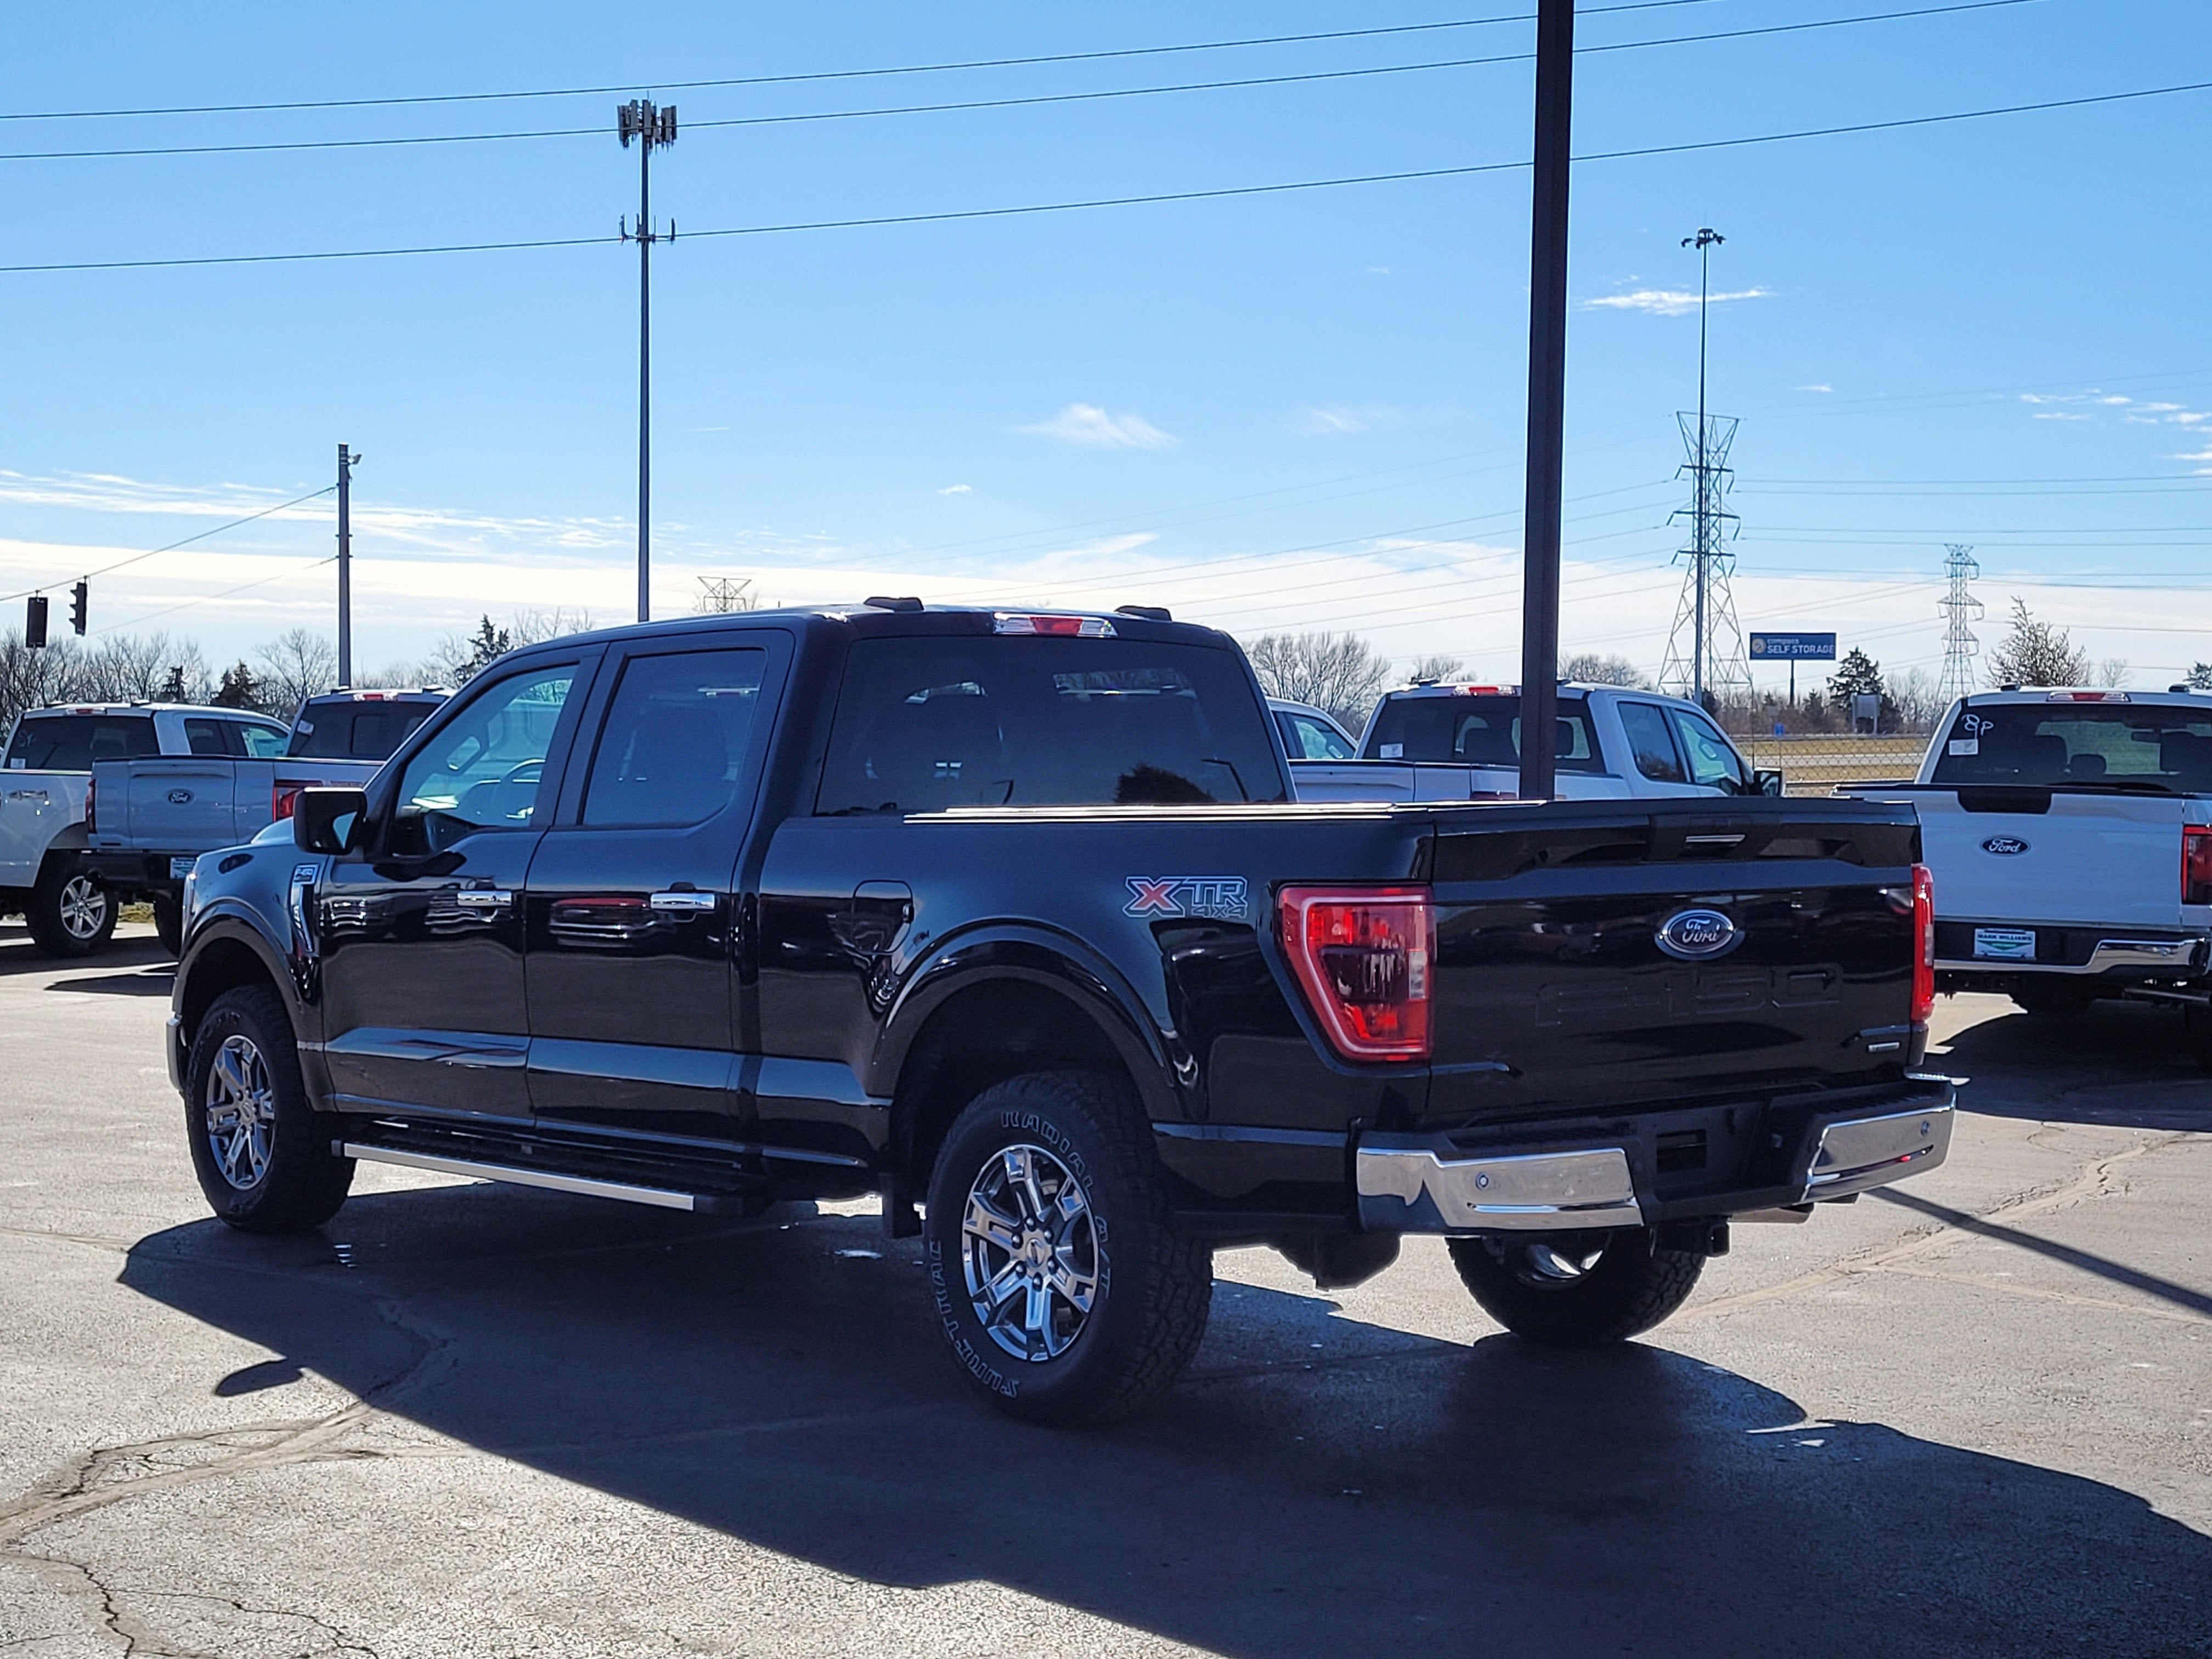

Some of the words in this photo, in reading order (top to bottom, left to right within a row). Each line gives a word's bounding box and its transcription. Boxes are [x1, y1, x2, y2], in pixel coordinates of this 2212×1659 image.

[1768, 645, 1790, 653] SELF
[1792, 645, 1834, 654] STORAGE
[1001, 1111, 1093, 1203] RADIAL
